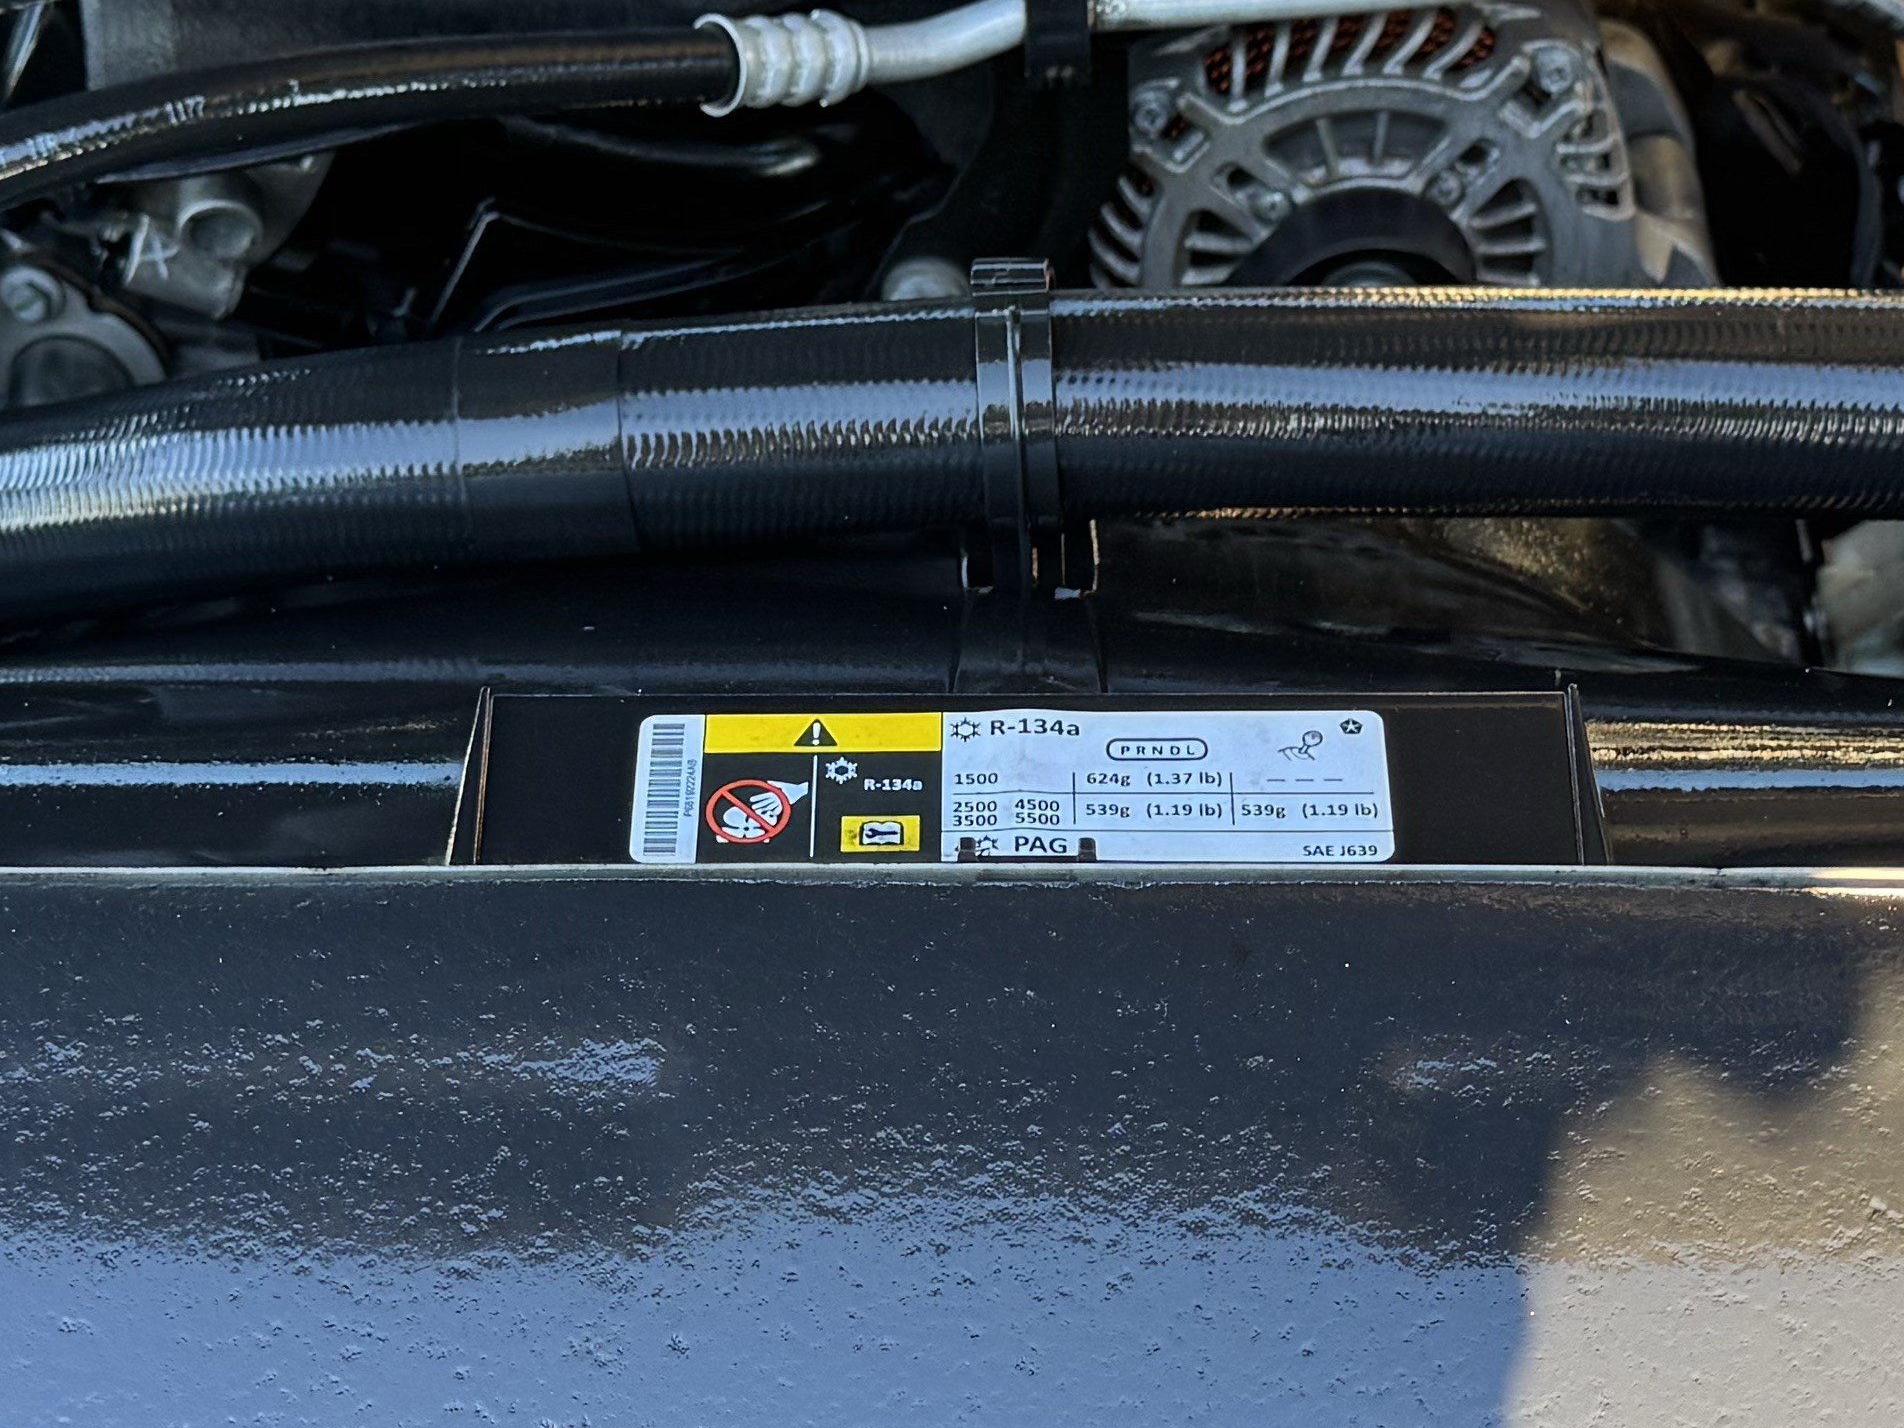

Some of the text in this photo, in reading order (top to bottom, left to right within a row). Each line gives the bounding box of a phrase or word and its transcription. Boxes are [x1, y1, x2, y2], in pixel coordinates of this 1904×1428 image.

[989, 718, 1081, 738] R-134a
[863, 777, 924, 792] R-134a
[953, 771, 1224, 789] 1500 624g (1.37 lb)
[952, 798, 1380, 820] 2500 4500 539g (1.19 lb) 539g (1.19 lb)
[951, 812, 1061, 827] 3500 5500
[1013, 835, 1069, 854] PAG
[1302, 844, 1379, 857] SAE J639
